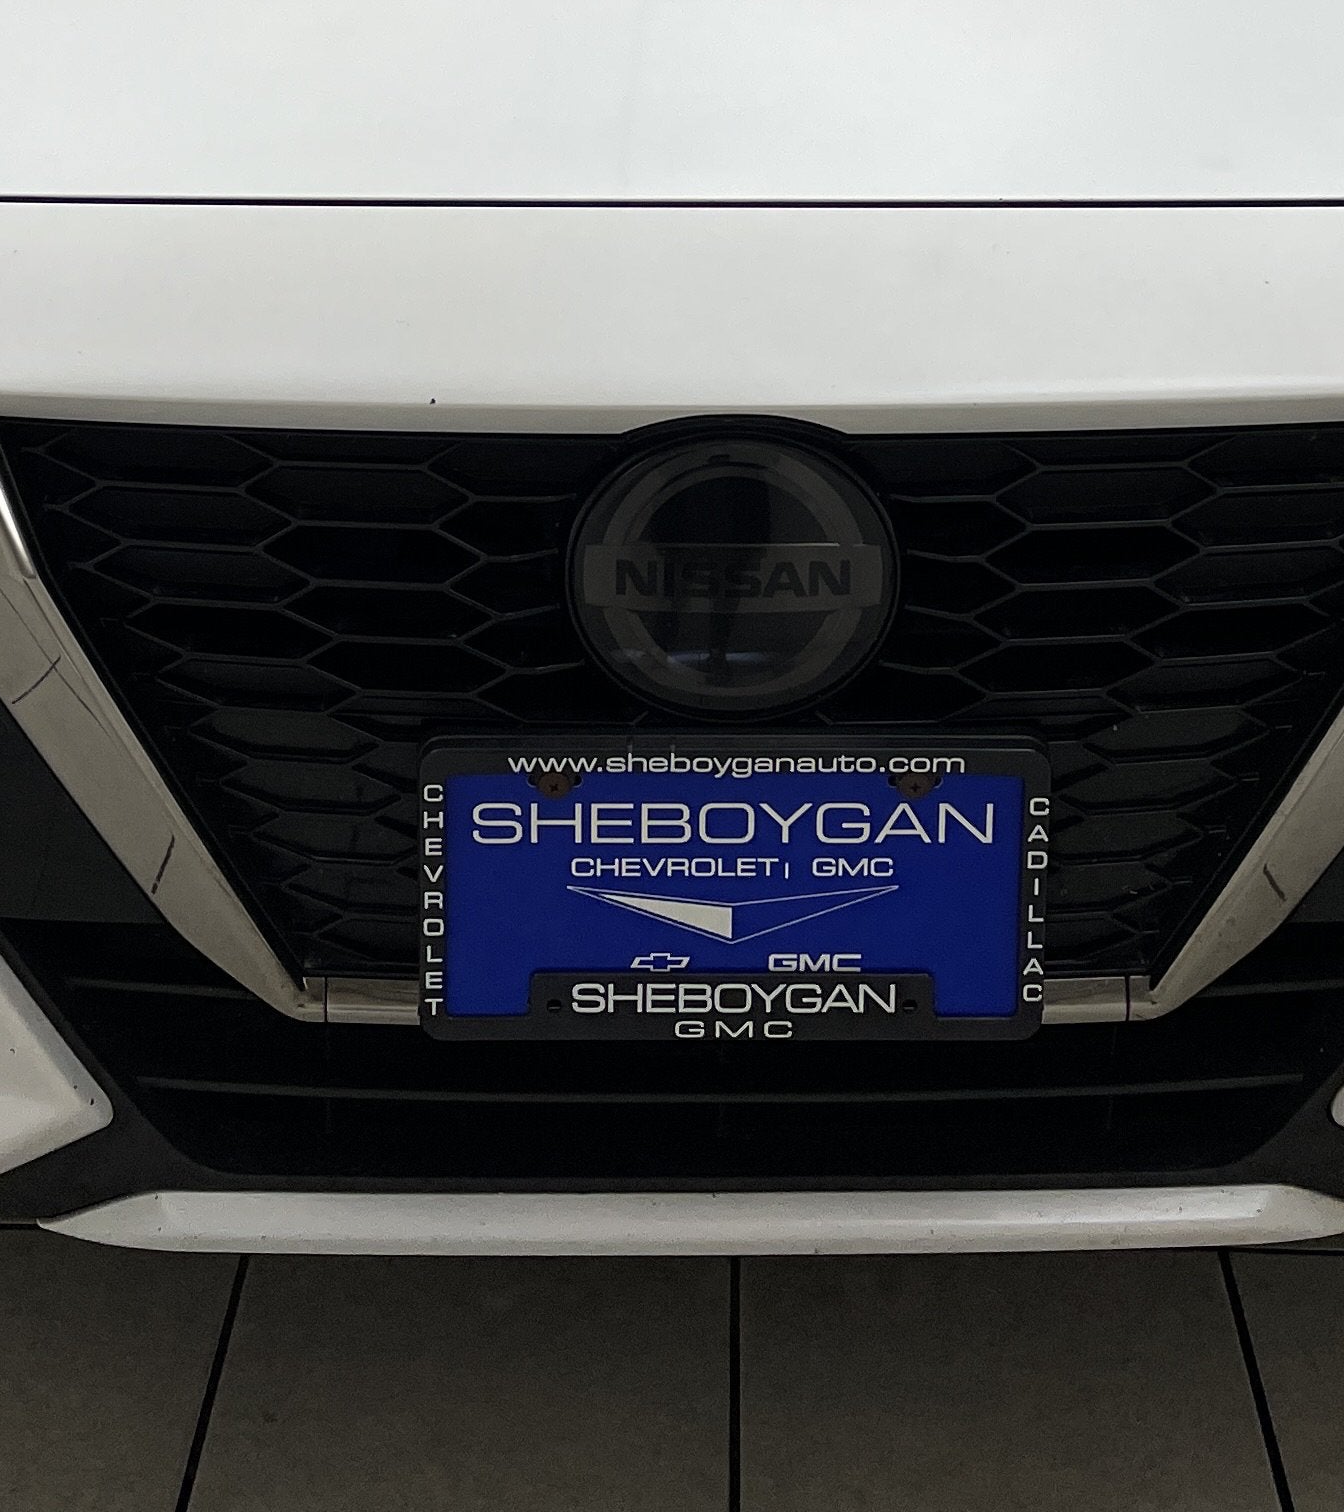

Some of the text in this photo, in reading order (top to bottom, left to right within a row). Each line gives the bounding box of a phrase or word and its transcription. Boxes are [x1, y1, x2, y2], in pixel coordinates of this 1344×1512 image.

[614, 559, 852, 598] NISSAN
[507, 752, 966, 778] www.sheboyganauto.com
[471, 801, 995, 845] SHEBOYGAN
[811, 857, 895, 878] GMC
[422, 783, 446, 1017] CHEVROLET
[1022, 796, 1051, 1003] CADILLAC
[767, 952, 862, 973] GMC
[570, 982, 897, 1015] SHEBOYGAN
[674, 1019, 794, 1039] GMC
